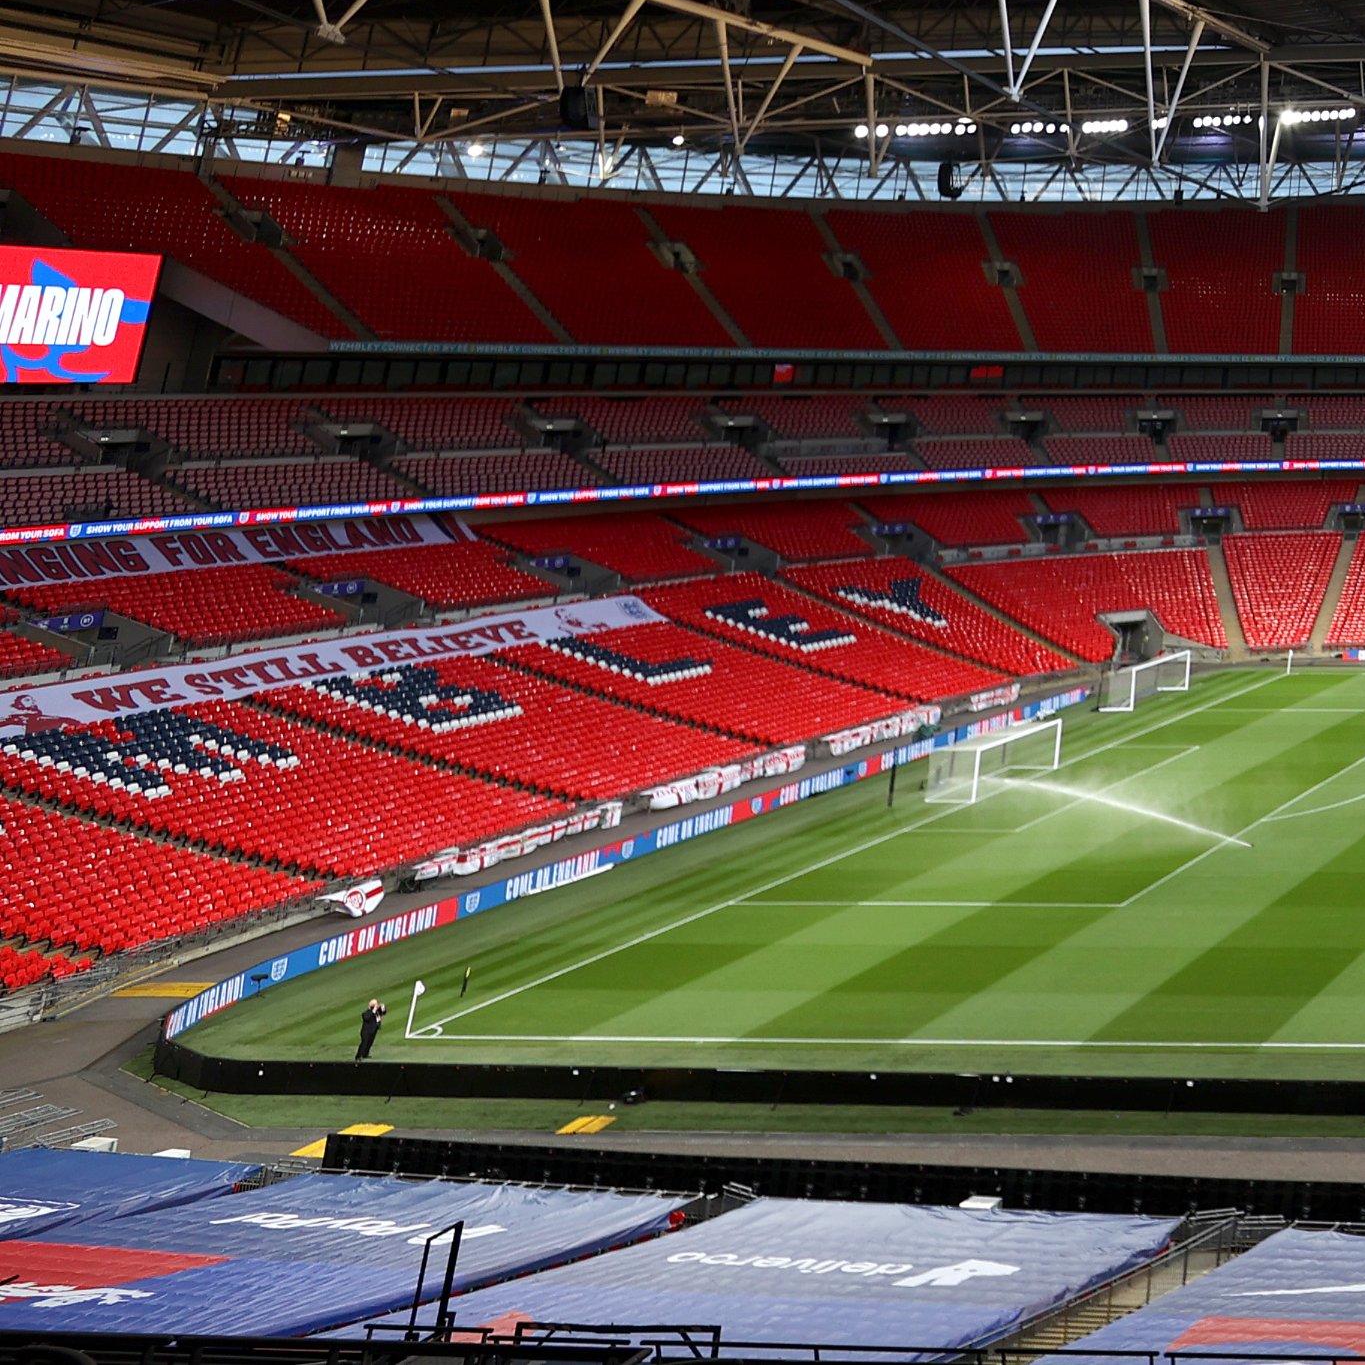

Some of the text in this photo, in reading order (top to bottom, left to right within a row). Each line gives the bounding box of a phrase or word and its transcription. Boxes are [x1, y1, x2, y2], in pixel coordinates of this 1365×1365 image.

[256, 502, 388, 522] SHOW YOUR SUPPORT FROM YOUR SOFA
[404, 494, 524, 511] SHOW YOUR SUPPORT FROM YOUR SOFA
[21, 528, 43, 539] YOUR
[43, 526, 65, 537] SOFA
[86, 514, 233, 535] SHOW YOUR SUPPORT FROM YOUR SOFA
[150, 533, 248, 567] FOR
[248, 517, 425, 558] ENGLAND
[72, 620, 538, 713] WE STILL BELIEVE
[656, 826, 680, 849] COME
[681, 820, 693, 841] ON
[506, 849, 600, 901] COME ON ENGLAND!
[319, 904, 438, 966] COME ON ENGLAND!
[168, 1013, 184, 1039] COME
[186, 1002, 200, 1027] ON
[211, 1212, 430, 1236] PayPal
[666, 1252, 913, 1276] deliveroo
